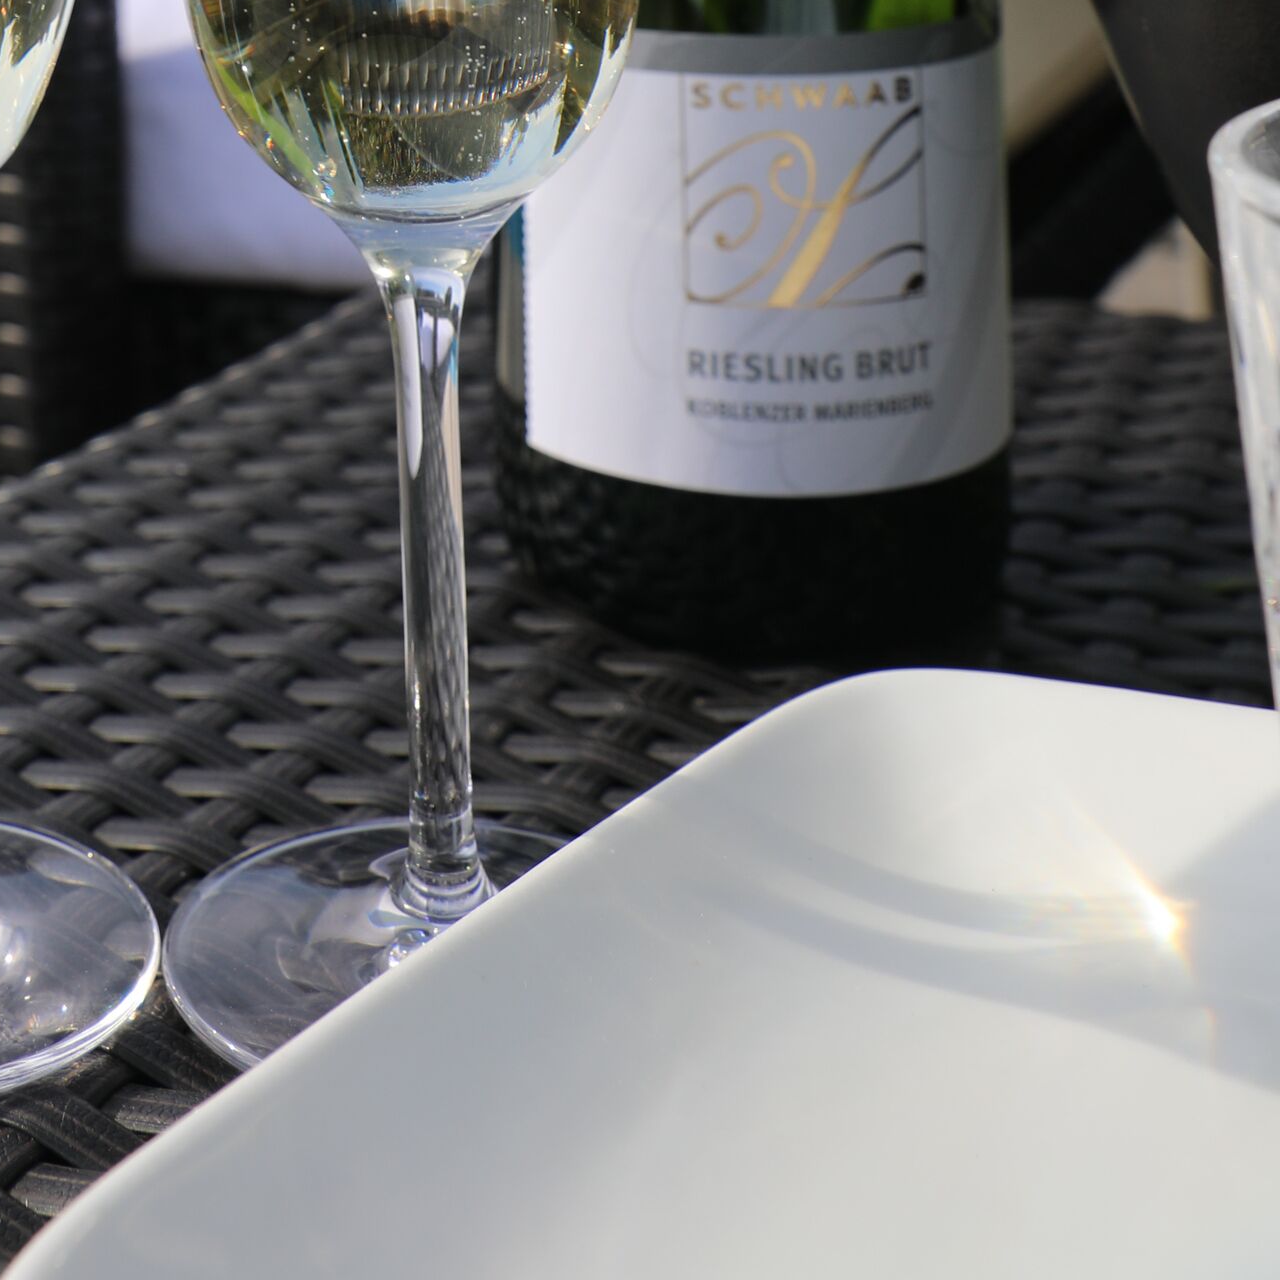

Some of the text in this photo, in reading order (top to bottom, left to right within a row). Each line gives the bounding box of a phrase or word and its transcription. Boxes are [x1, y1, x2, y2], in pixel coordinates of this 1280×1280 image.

[691, 75, 913, 111] SCHWAAB
[687, 342, 931, 383] RIESLING BRUT
